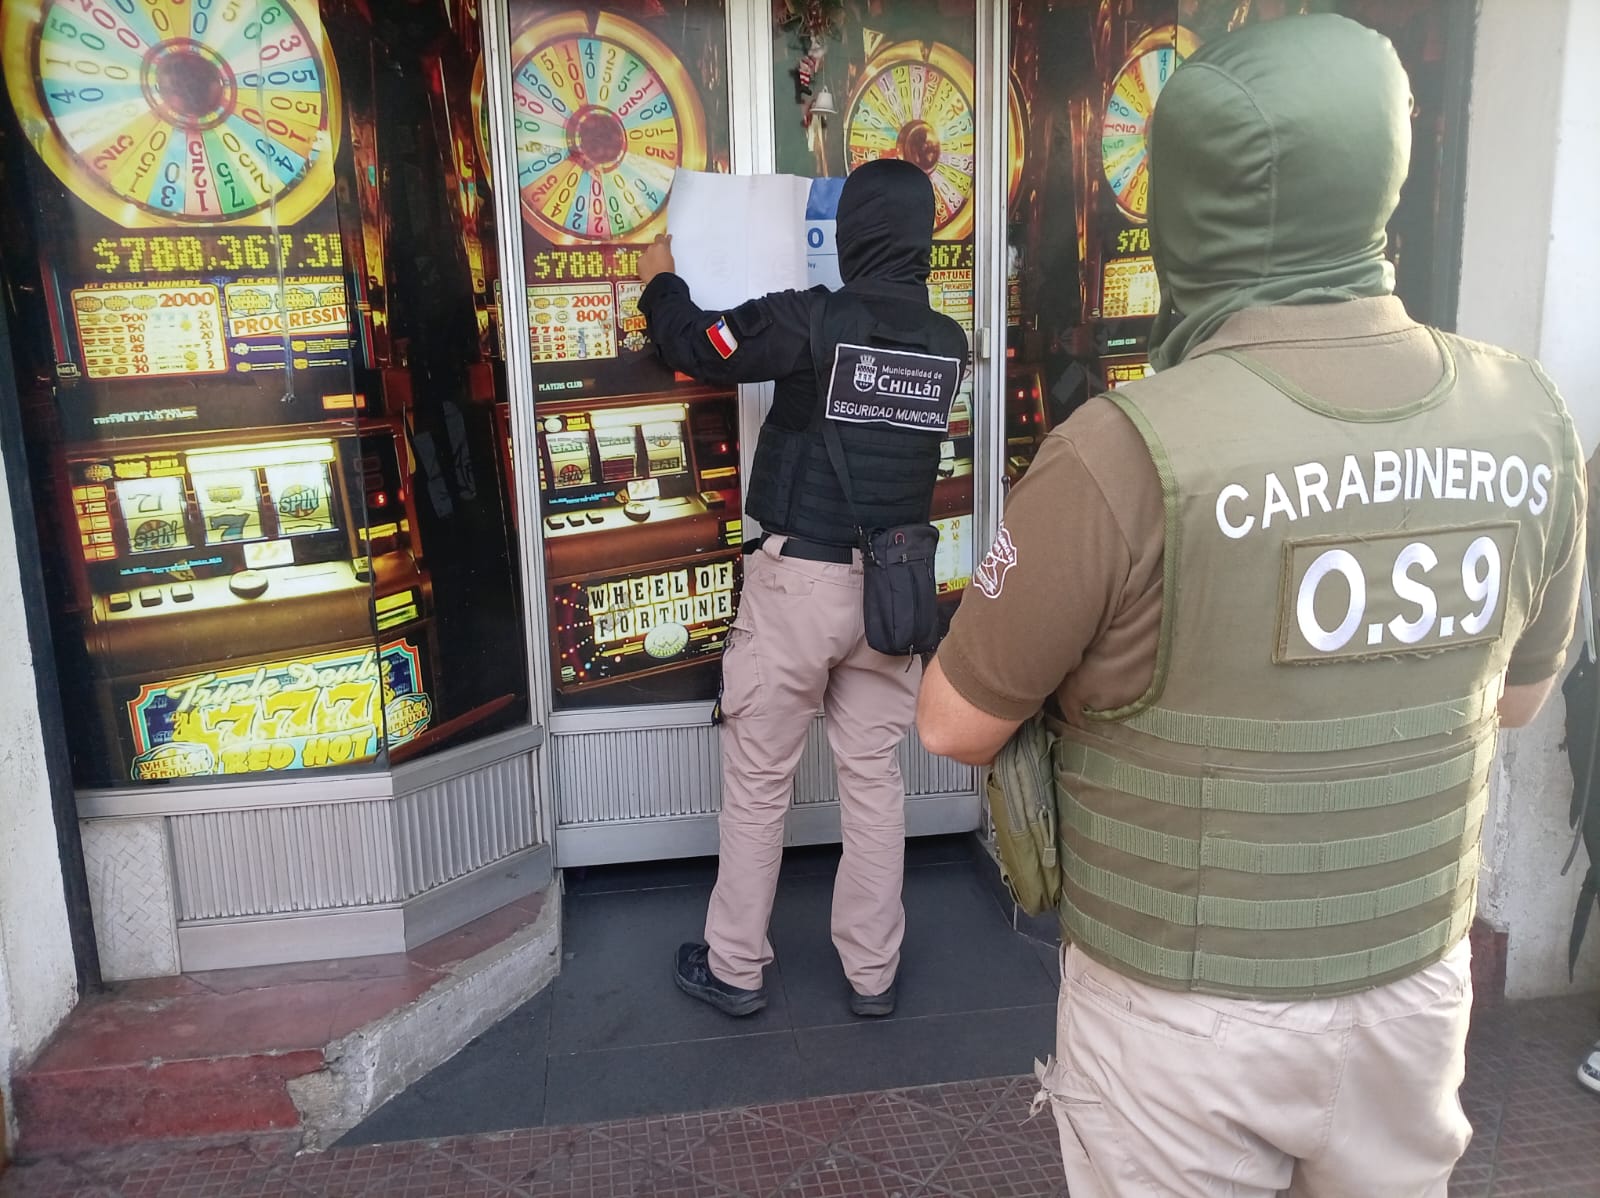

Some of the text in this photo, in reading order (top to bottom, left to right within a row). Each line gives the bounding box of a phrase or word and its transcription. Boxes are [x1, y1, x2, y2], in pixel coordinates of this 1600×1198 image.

[50, 18, 105, 50] 50
[243, 6, 281, 40] 60
[259, 34, 302, 61] 30
[584, 42, 595, 79] 40
[46, 57, 129, 80] 100
[243, 69, 316, 87] 500
[541, 51, 564, 88] 50
[563, 44, 585, 100] 100
[599, 48, 616, 101] 250
[618, 60, 639, 92] 75
[1160, 51, 1167, 82] 40
[50, 87, 104, 104] 40
[270, 96, 318, 115] 50
[521, 68, 566, 112] 500
[618, 79, 654, 116] 125
[242, 108, 310, 143] 100
[639, 102, 668, 120] 30
[1109, 99, 1130, 118] 30
[629, 127, 674, 140] 150
[1104, 122, 1137, 134] 125
[94, 134, 134, 170] 25
[129, 131, 167, 193] 150
[222, 132, 272, 194] 250
[519, 152, 562, 176] 100
[645, 145, 676, 161] 25
[161, 162, 180, 208] 30
[188, 141, 209, 212] 125
[216, 163, 245, 208] 75
[531, 174, 558, 202] 25
[634, 178, 658, 205] 40
[550, 172, 578, 218] 400
[572, 195, 585, 230] 20
[592, 180, 604, 233] 200
[613, 174, 643, 219] 100
[609, 196, 625, 231] 50
[159, 292, 215, 308] 2000
[571, 294, 611, 308] 2000
[576, 310, 608, 322] 800
[881, 365, 943, 380] Municipalidad de
[833, 400, 946, 426] SEGURIDAD MUNICIPAL
[279, 487, 320, 515] SPIN
[1215, 447, 1551, 539] CARABINEROS
[591, 567, 729, 610] WHEEL OF
[1296, 536, 1501, 652] O.S.9
[599, 595, 728, 638] FORTUNE
[166, 666, 282, 713] Triple
[285, 649, 392, 690] Double
[222, 730, 373, 774] RED HOT
